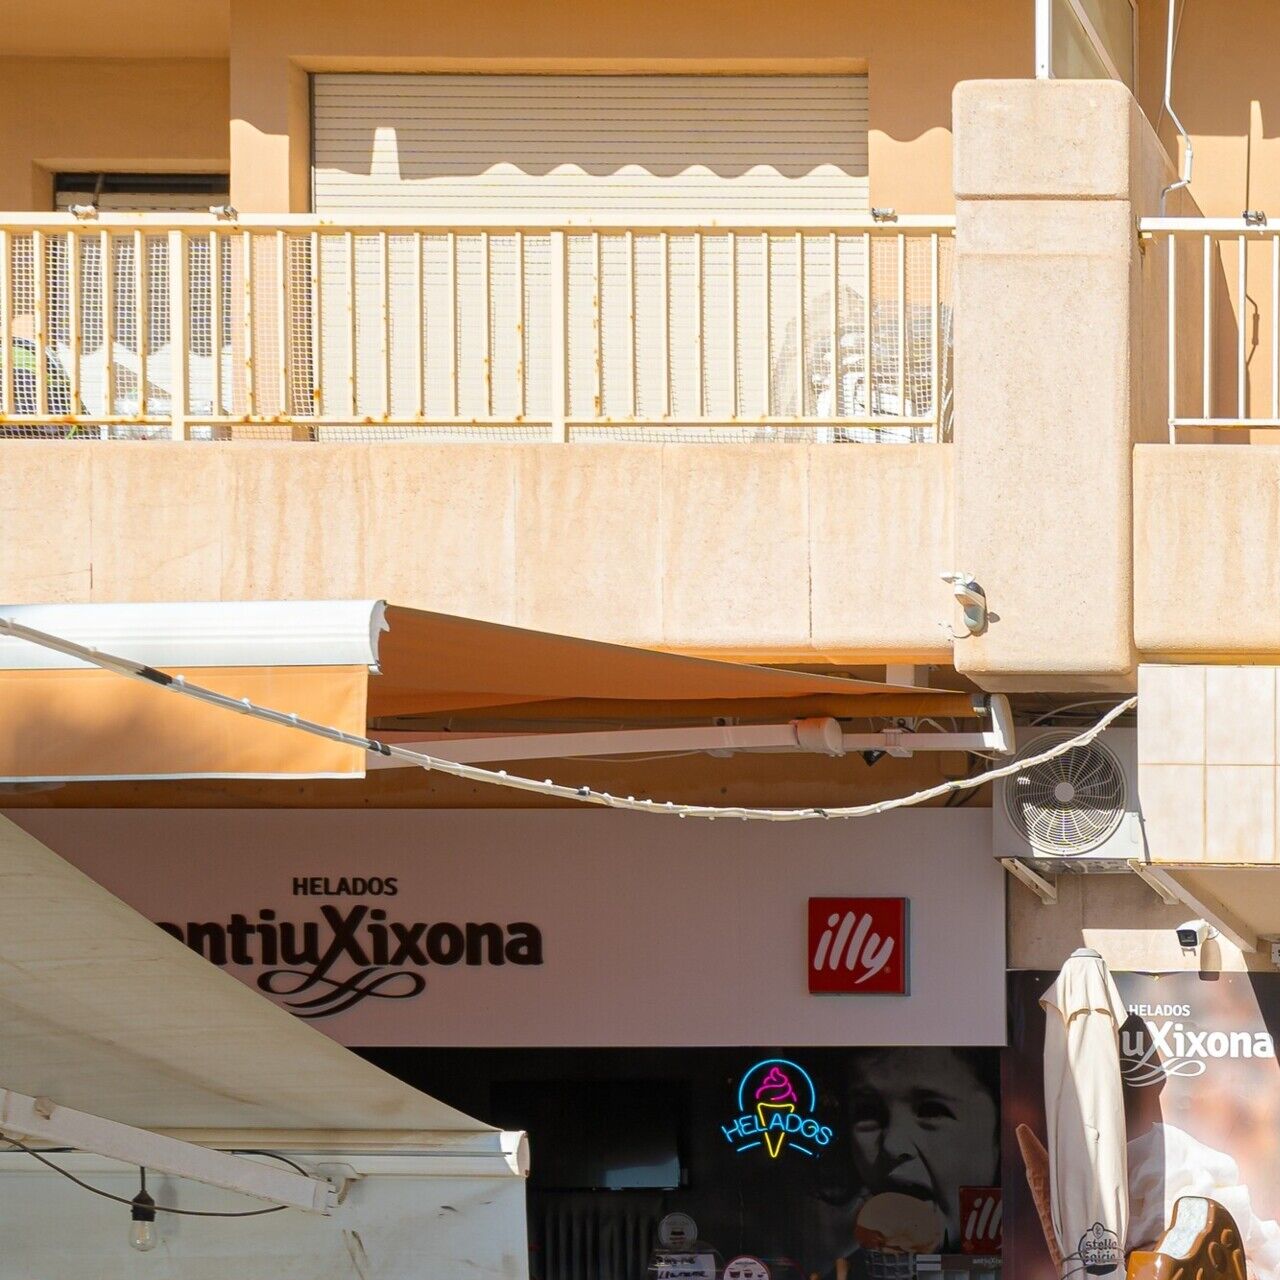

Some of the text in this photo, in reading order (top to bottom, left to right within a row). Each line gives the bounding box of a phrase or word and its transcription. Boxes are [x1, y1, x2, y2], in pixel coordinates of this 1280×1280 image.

[292, 877, 398, 896] HELADOS
[814, 911, 895, 984] illy
[1128, 1004, 1191, 1017] HELADOS
[721, 1112, 833, 1146] HELADOS
[965, 1196, 1003, 1247] ill
